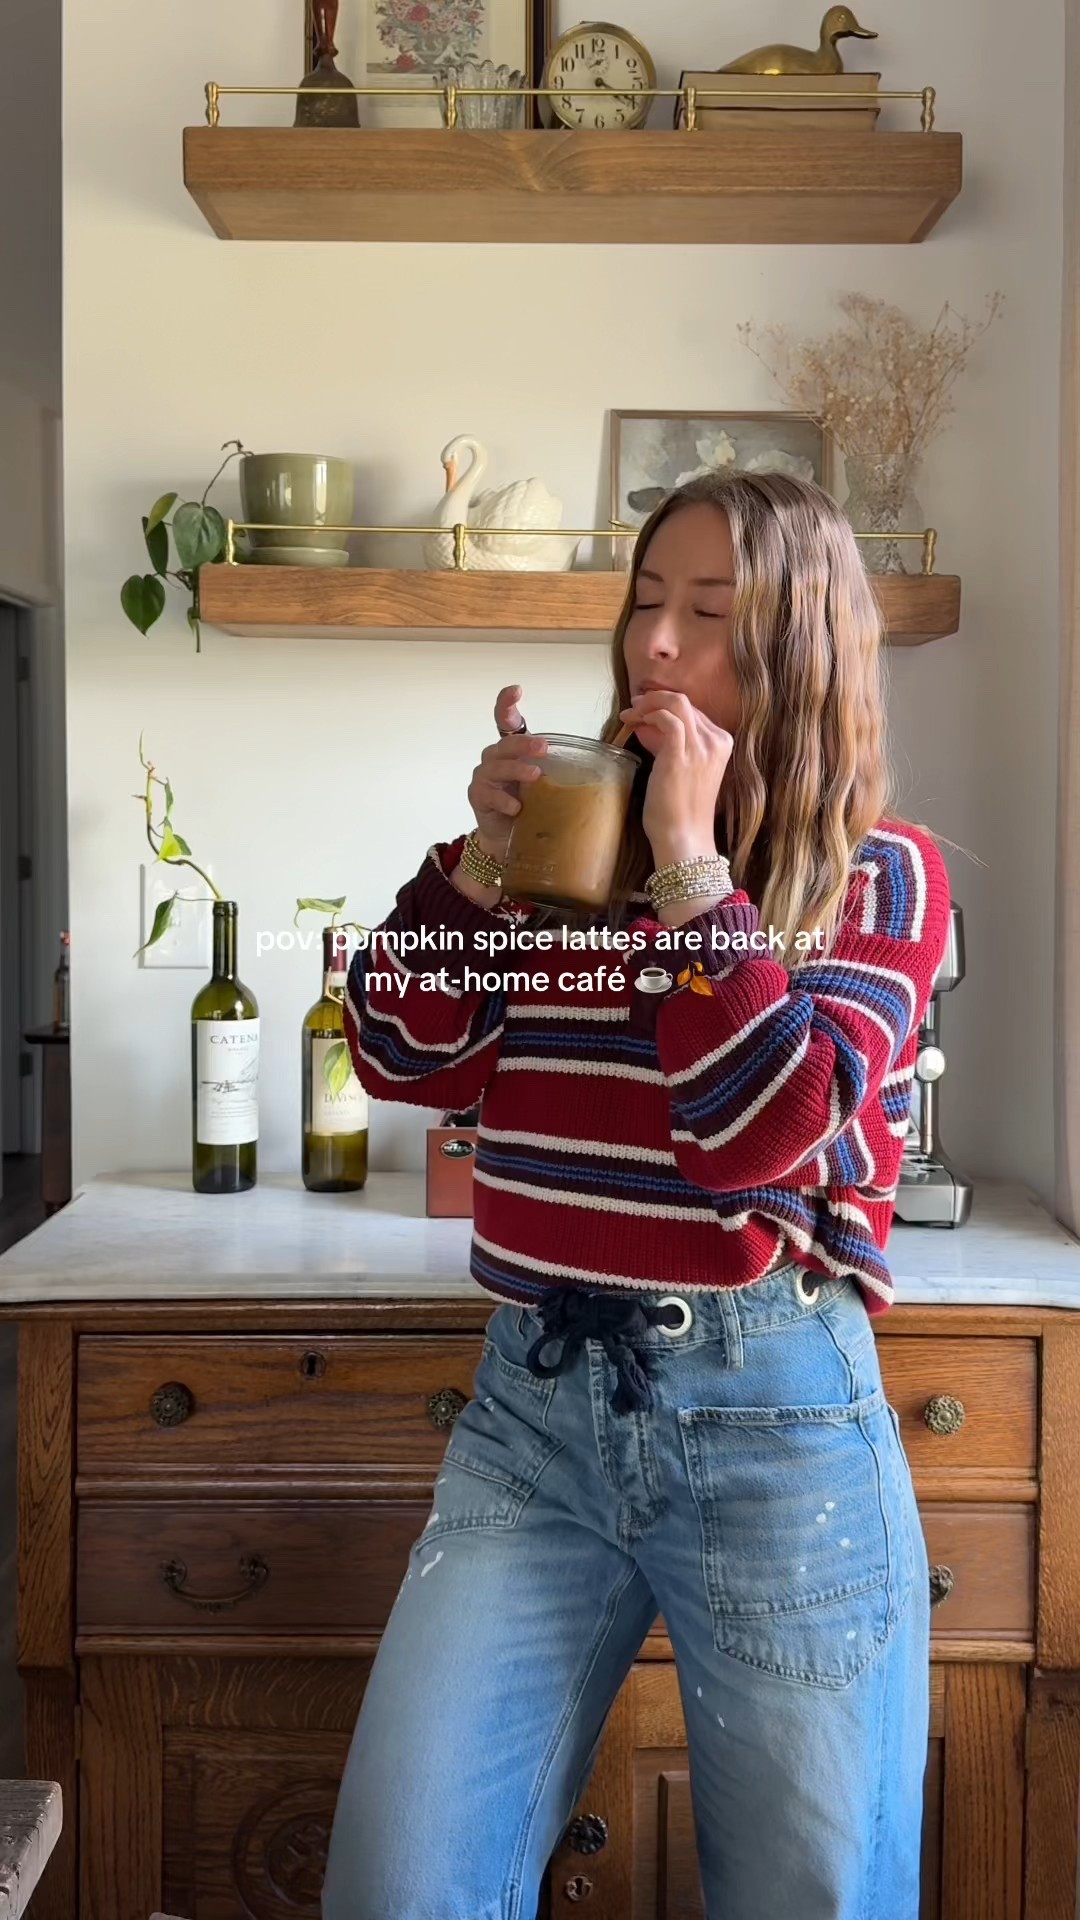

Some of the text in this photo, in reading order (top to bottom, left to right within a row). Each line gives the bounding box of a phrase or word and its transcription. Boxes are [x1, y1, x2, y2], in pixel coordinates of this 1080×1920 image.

[575, 44, 585, 59] 11
[592, 38, 605, 53] 12
[615, 44, 619, 59] 1
[561, 57, 575, 72] 10
[626, 59, 637, 74] 2
[554, 76, 564, 90] 9
[561, 94, 572, 109] 8
[575, 108, 585, 123] 7
[594, 115, 605, 128] 6
[615, 109, 625, 122] 5
